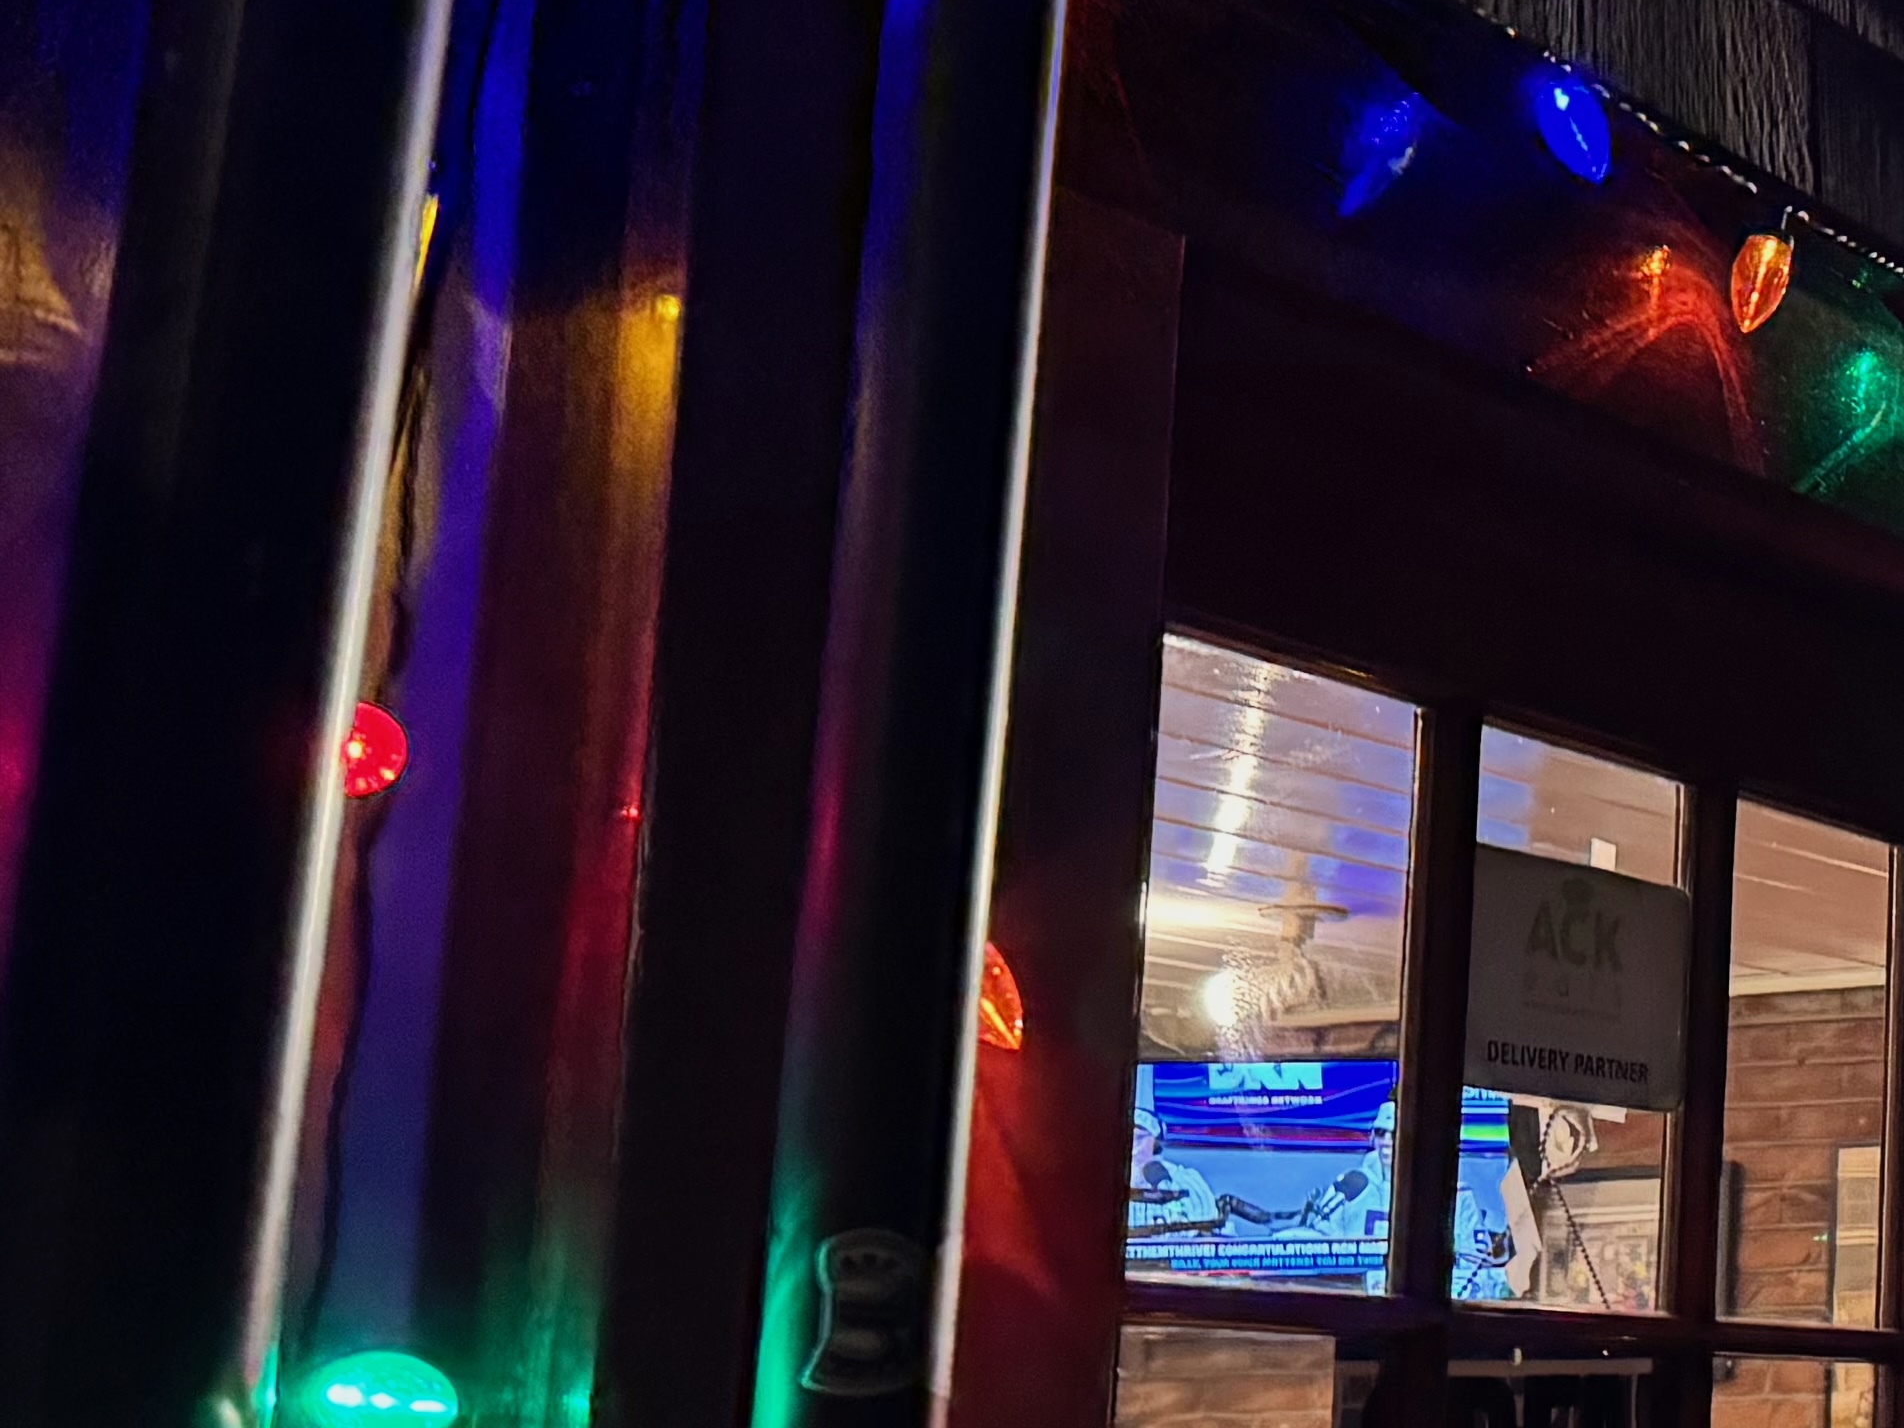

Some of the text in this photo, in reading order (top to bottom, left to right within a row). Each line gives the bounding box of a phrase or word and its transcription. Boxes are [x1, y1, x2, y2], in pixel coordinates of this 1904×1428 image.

[1526, 899, 1623, 973] ACK
[1486, 1039, 1650, 1084] DELIVERY PARTNER
